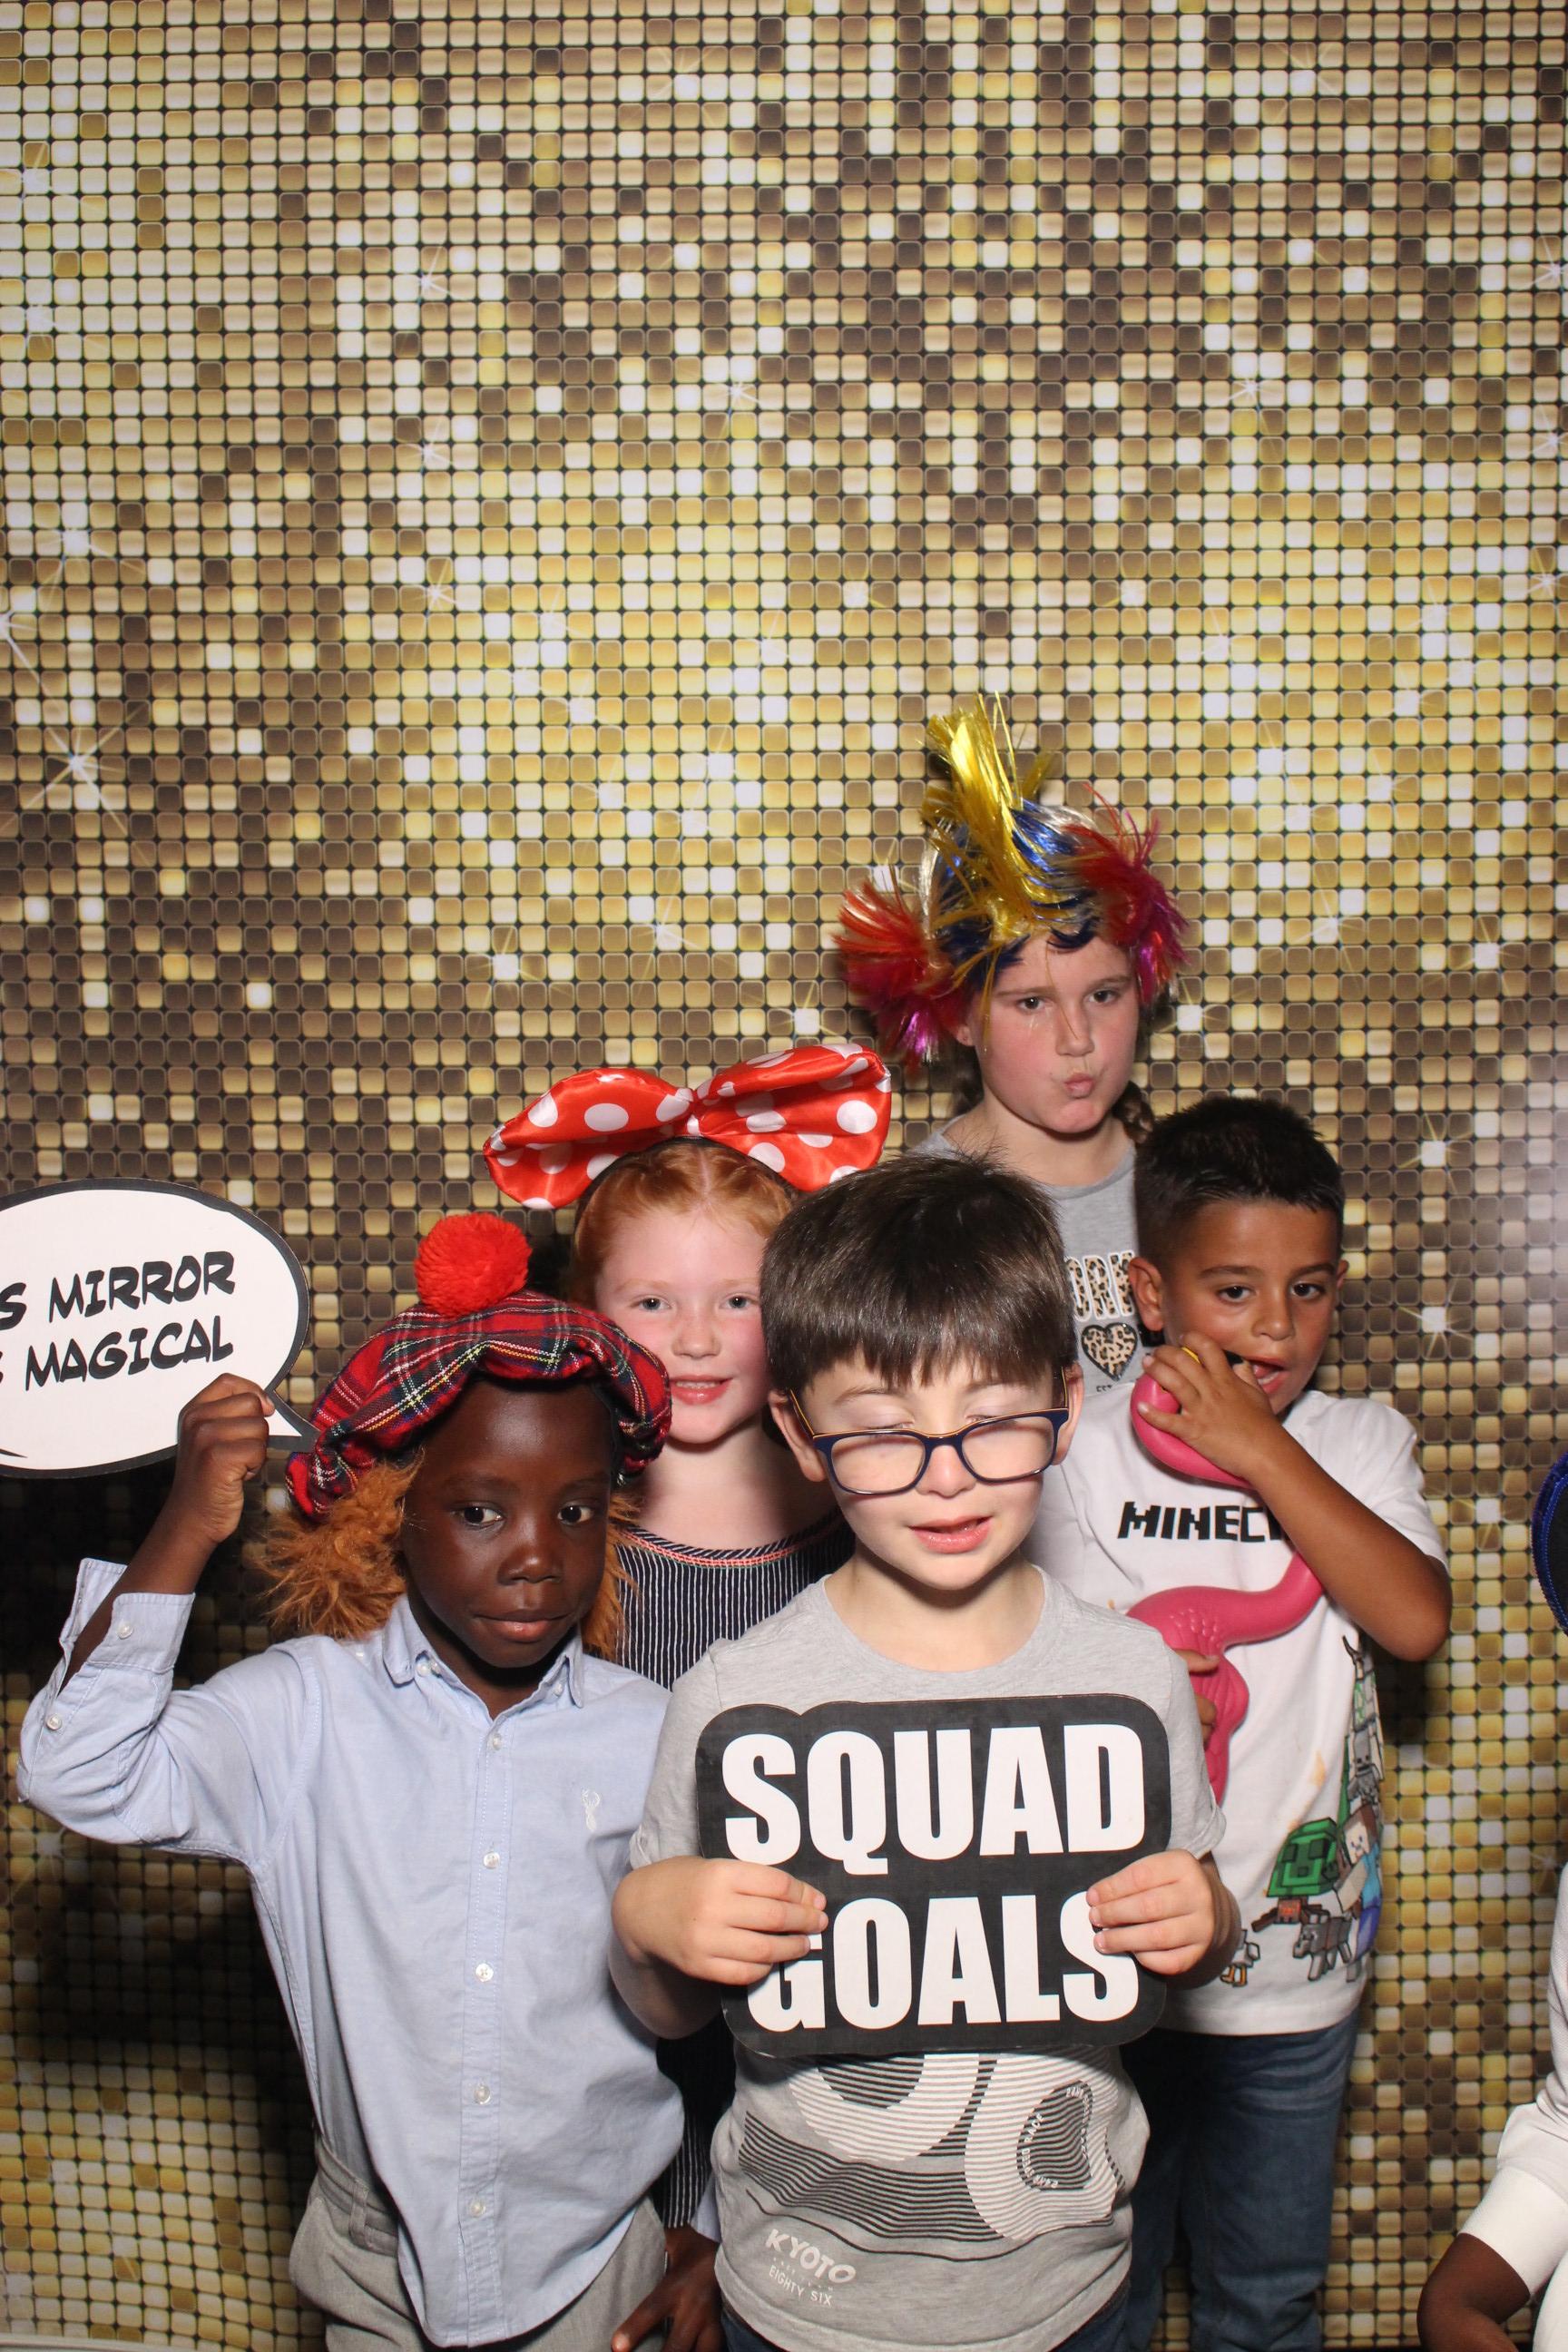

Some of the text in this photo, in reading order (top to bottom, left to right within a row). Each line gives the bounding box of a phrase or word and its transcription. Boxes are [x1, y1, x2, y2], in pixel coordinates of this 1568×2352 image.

[49, 1250, 235, 1323] MIRROR
[25, 1316, 234, 1391] MAGICAL
[722, 1724, 1145, 1875] SQUAD
[765, 2229, 857, 2283] KYOTO
[769, 2265, 804, 2298] EIGHTY
[810, 2290, 832, 2306] SIX
